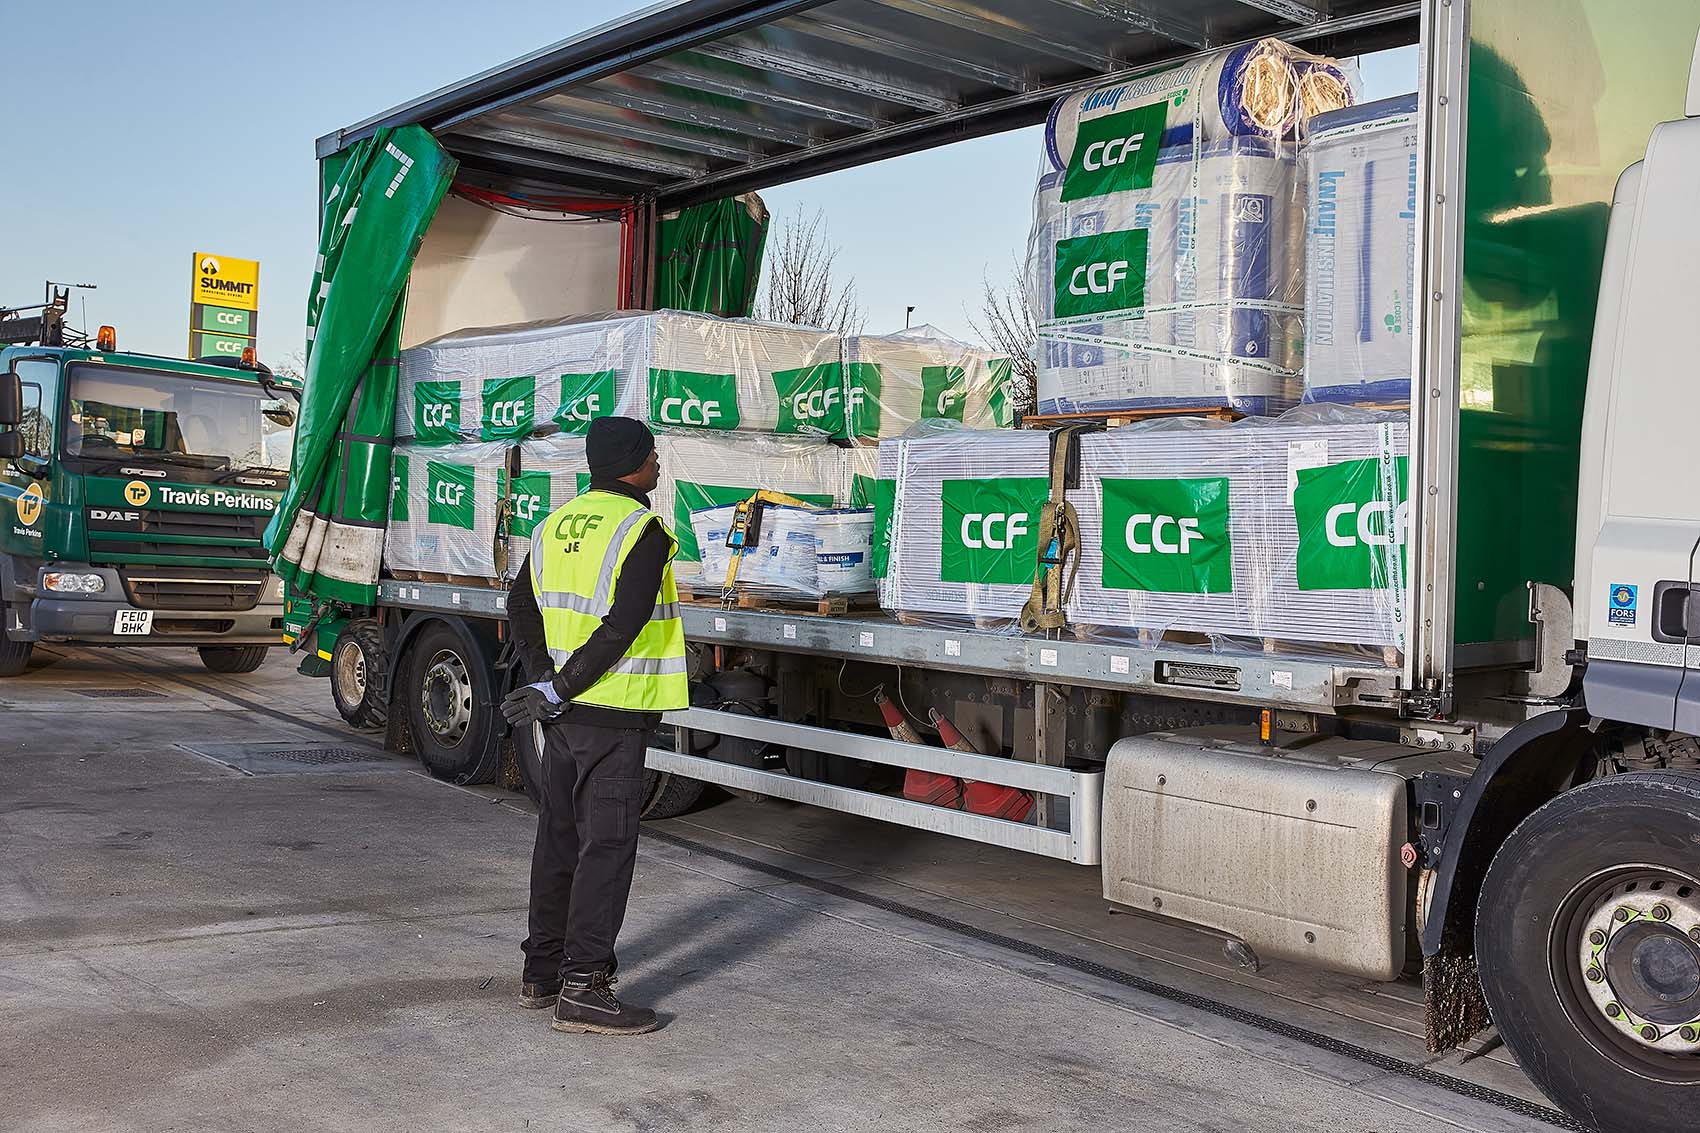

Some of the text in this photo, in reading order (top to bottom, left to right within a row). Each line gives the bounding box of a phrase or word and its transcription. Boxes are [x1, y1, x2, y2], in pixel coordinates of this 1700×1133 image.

[1083, 132, 1145, 172] CCF
[201, 276, 254, 295] SUMMIT
[1068, 260, 1129, 297] CCF
[217, 312, 243, 325] CCF
[215, 340, 242, 353] CCF
[423, 403, 452, 427] CCF
[490, 401, 525, 426] CCF
[660, 397, 722, 426] CCF
[793, 387, 841, 420] CCF
[159, 486, 210, 506] Travis
[214, 491, 274, 511] Perkins
[434, 479, 466, 506] CCF
[90, 510, 140, 521] DAF
[555, 514, 603, 541] CCF
[961, 512, 1028, 549] CCF
[1125, 513, 1204, 554] CCF
[1388, 527, 1396, 544] CCF
[564, 541, 580, 554] JE
[121, 611, 148, 622] FE10
[1394, 607, 1402, 623] CCF
[1611, 608, 1634, 617] FORS
[121, 622, 144, 634] BHK
